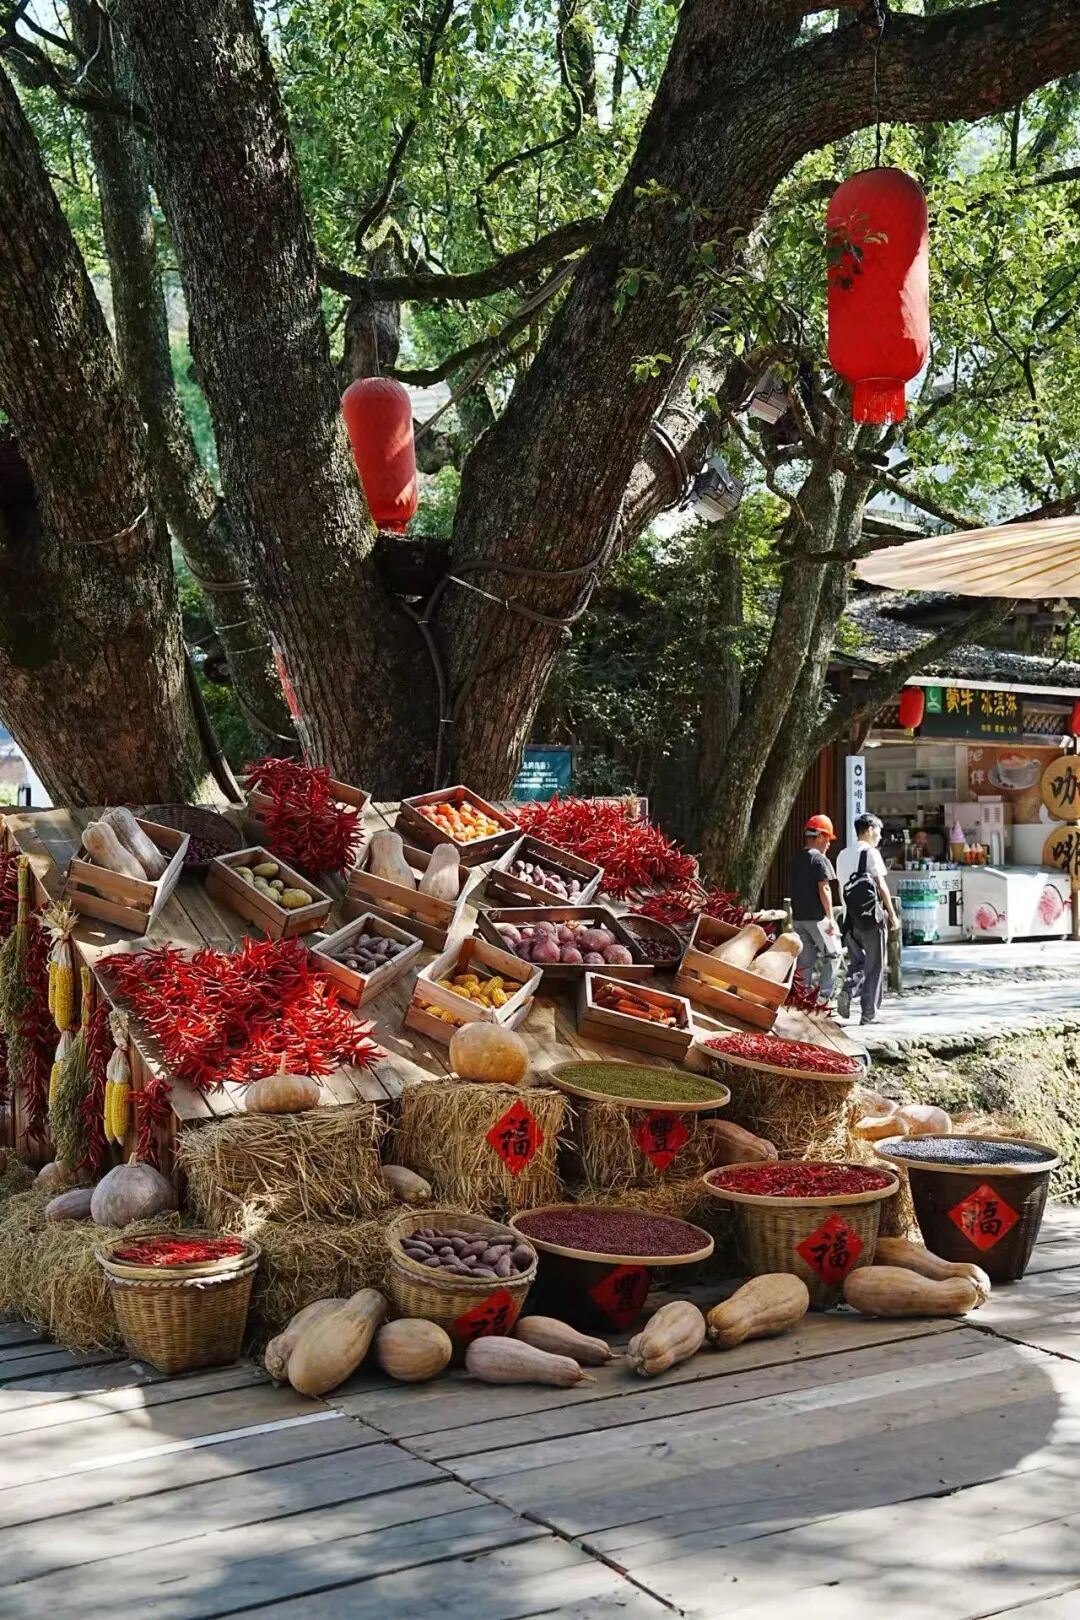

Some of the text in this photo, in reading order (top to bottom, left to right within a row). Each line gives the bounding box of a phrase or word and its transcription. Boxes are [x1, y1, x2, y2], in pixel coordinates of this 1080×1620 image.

[500, 1117, 530, 1157] 福
[960, 1198, 1003, 1238] 福
[808, 1229, 851, 1271] 福
